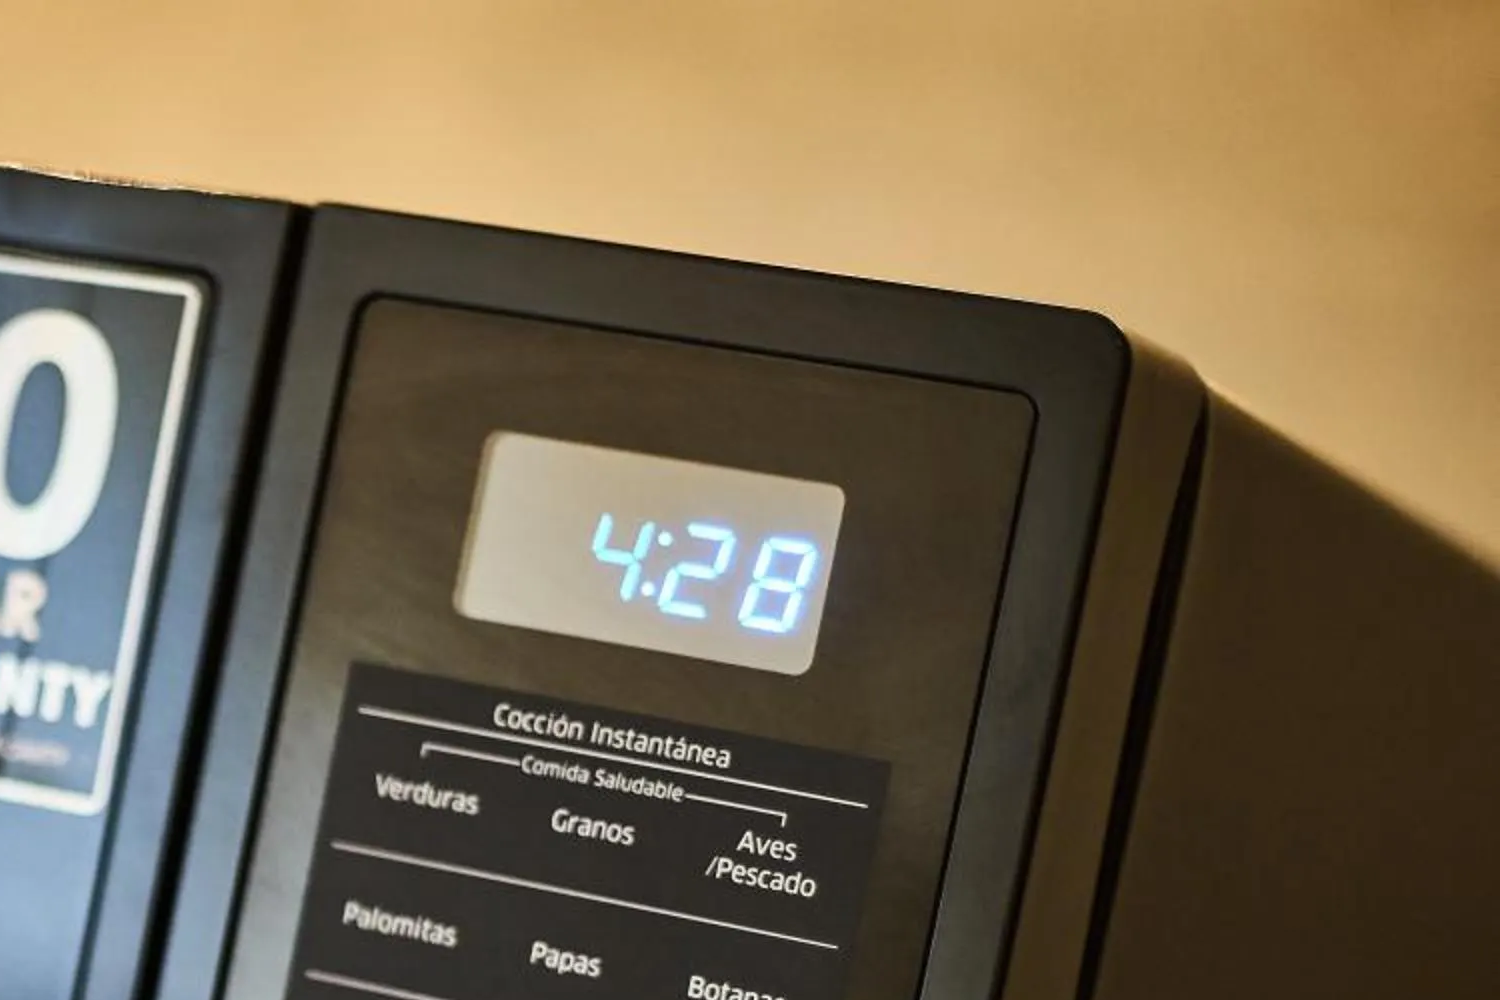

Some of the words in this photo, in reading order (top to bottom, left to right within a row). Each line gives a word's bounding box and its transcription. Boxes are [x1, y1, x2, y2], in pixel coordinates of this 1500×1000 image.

[591, 512, 817, 634] 4:28
[492, 700, 584, 742] Cocción
[590, 719, 733, 771] Instantánea
[374, 772, 481, 816] Verduras
[520, 753, 590, 786] Comida
[594, 766, 684, 803] Saludable
[550, 807, 636, 847] Granos
[737, 828, 798, 862] Aves
[704, 854, 817, 899] /Pescado
[340, 901, 459, 948] Palomitas
[529, 940, 602, 979] Papas
